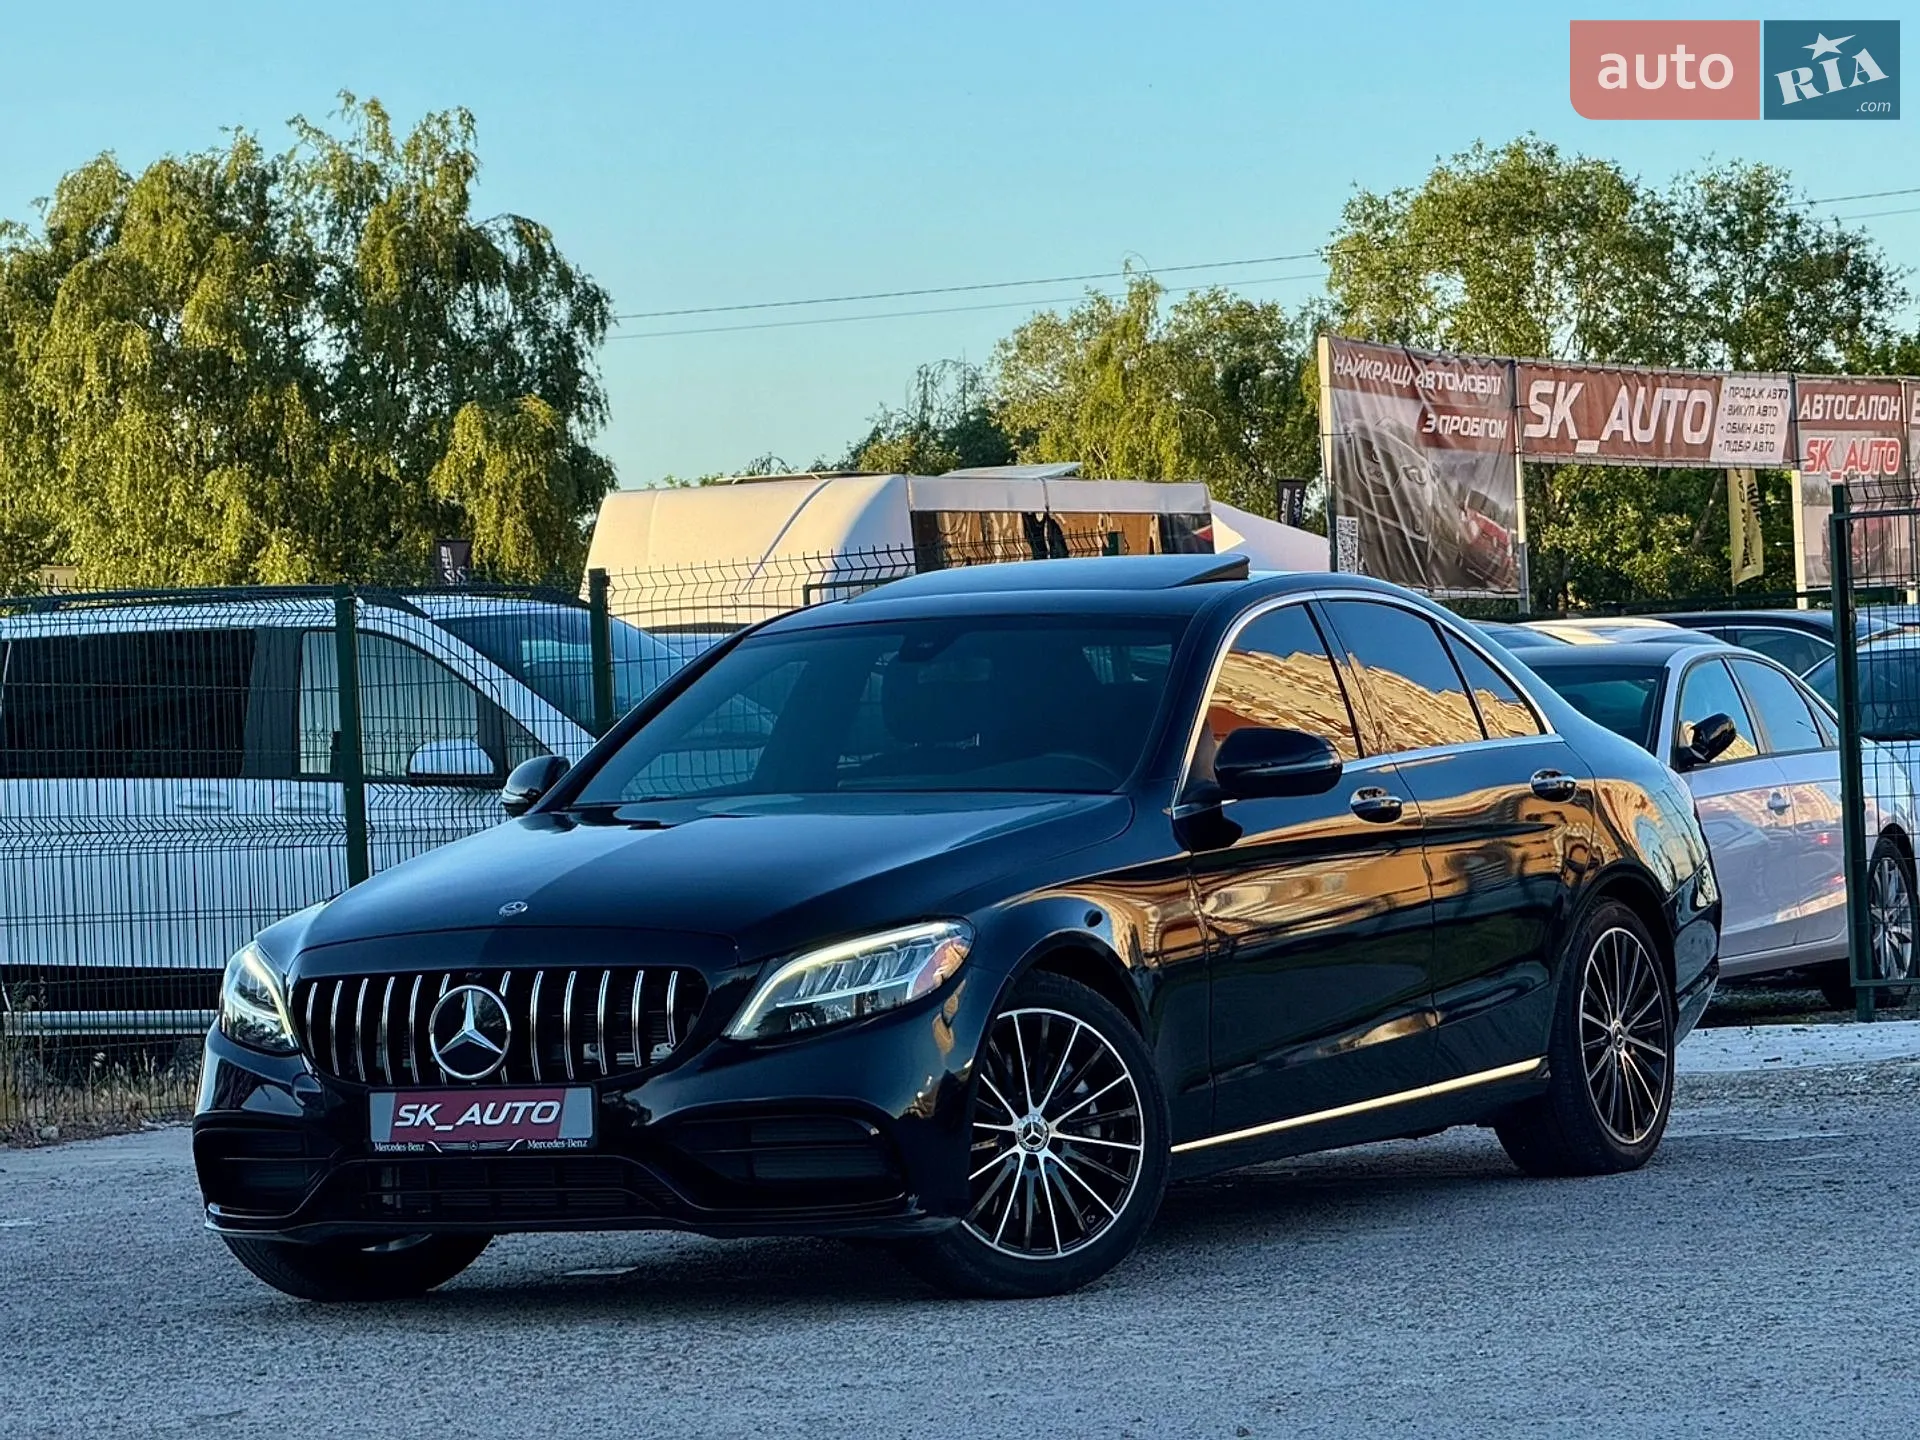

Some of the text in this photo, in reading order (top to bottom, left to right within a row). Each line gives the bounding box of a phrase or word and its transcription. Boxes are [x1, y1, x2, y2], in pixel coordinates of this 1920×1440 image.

[1333, 353, 1502, 395] НАЙКРАЩІ АВТОМОБІЛІ
[1729, 386, 1789, 400] ПРОДАЖ АВТО
[1524, 379, 1713, 454] SK_AUTO
[1727, 405, 1779, 417] ВИКУП АВТО
[1798, 394, 1901, 421] АВТОСАЛОН
[1438, 414, 1508, 440] ПРОБІГОМ
[1725, 422, 1776, 435] ОБМІН АВТО
[1752, 441, 1775, 453] АВТО
[1802, 437, 1902, 482] SK_AUTO
[394, 1100, 561, 1132] SK_AUTO
[374, 1141, 426, 1152] Mercedes-Benz
[527, 1138, 588, 1150] Mercedes-Benz
